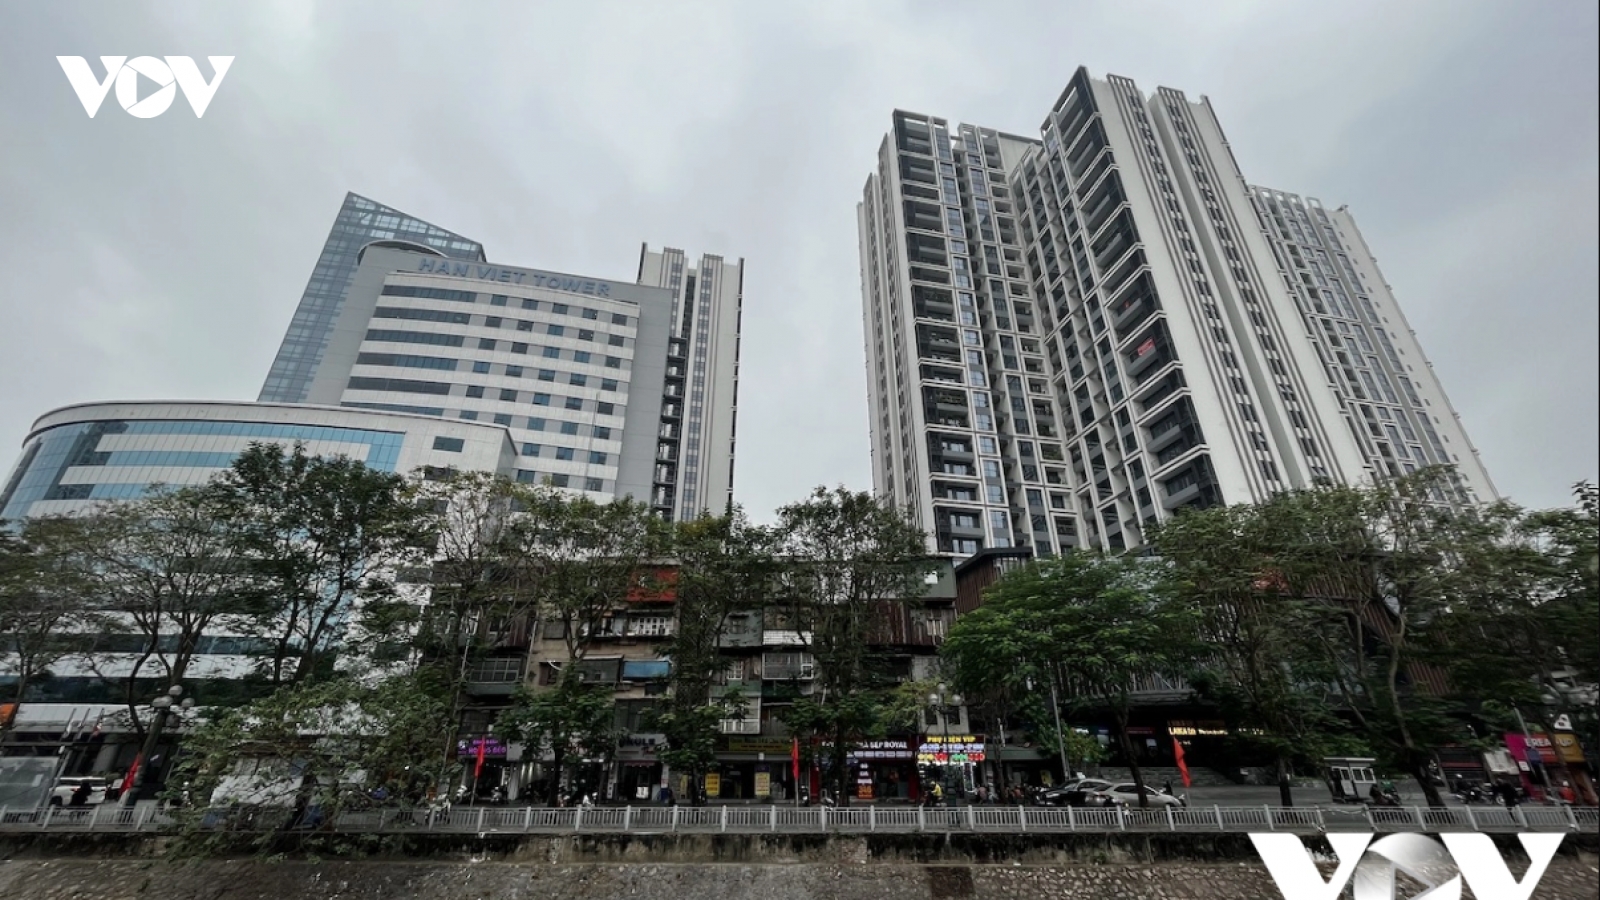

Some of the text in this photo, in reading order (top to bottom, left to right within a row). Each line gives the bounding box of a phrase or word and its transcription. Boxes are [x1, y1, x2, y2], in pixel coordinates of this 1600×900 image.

[418, 257, 612, 297] HAN VIET TOWER
[883, 741, 908, 749] ROYAL
